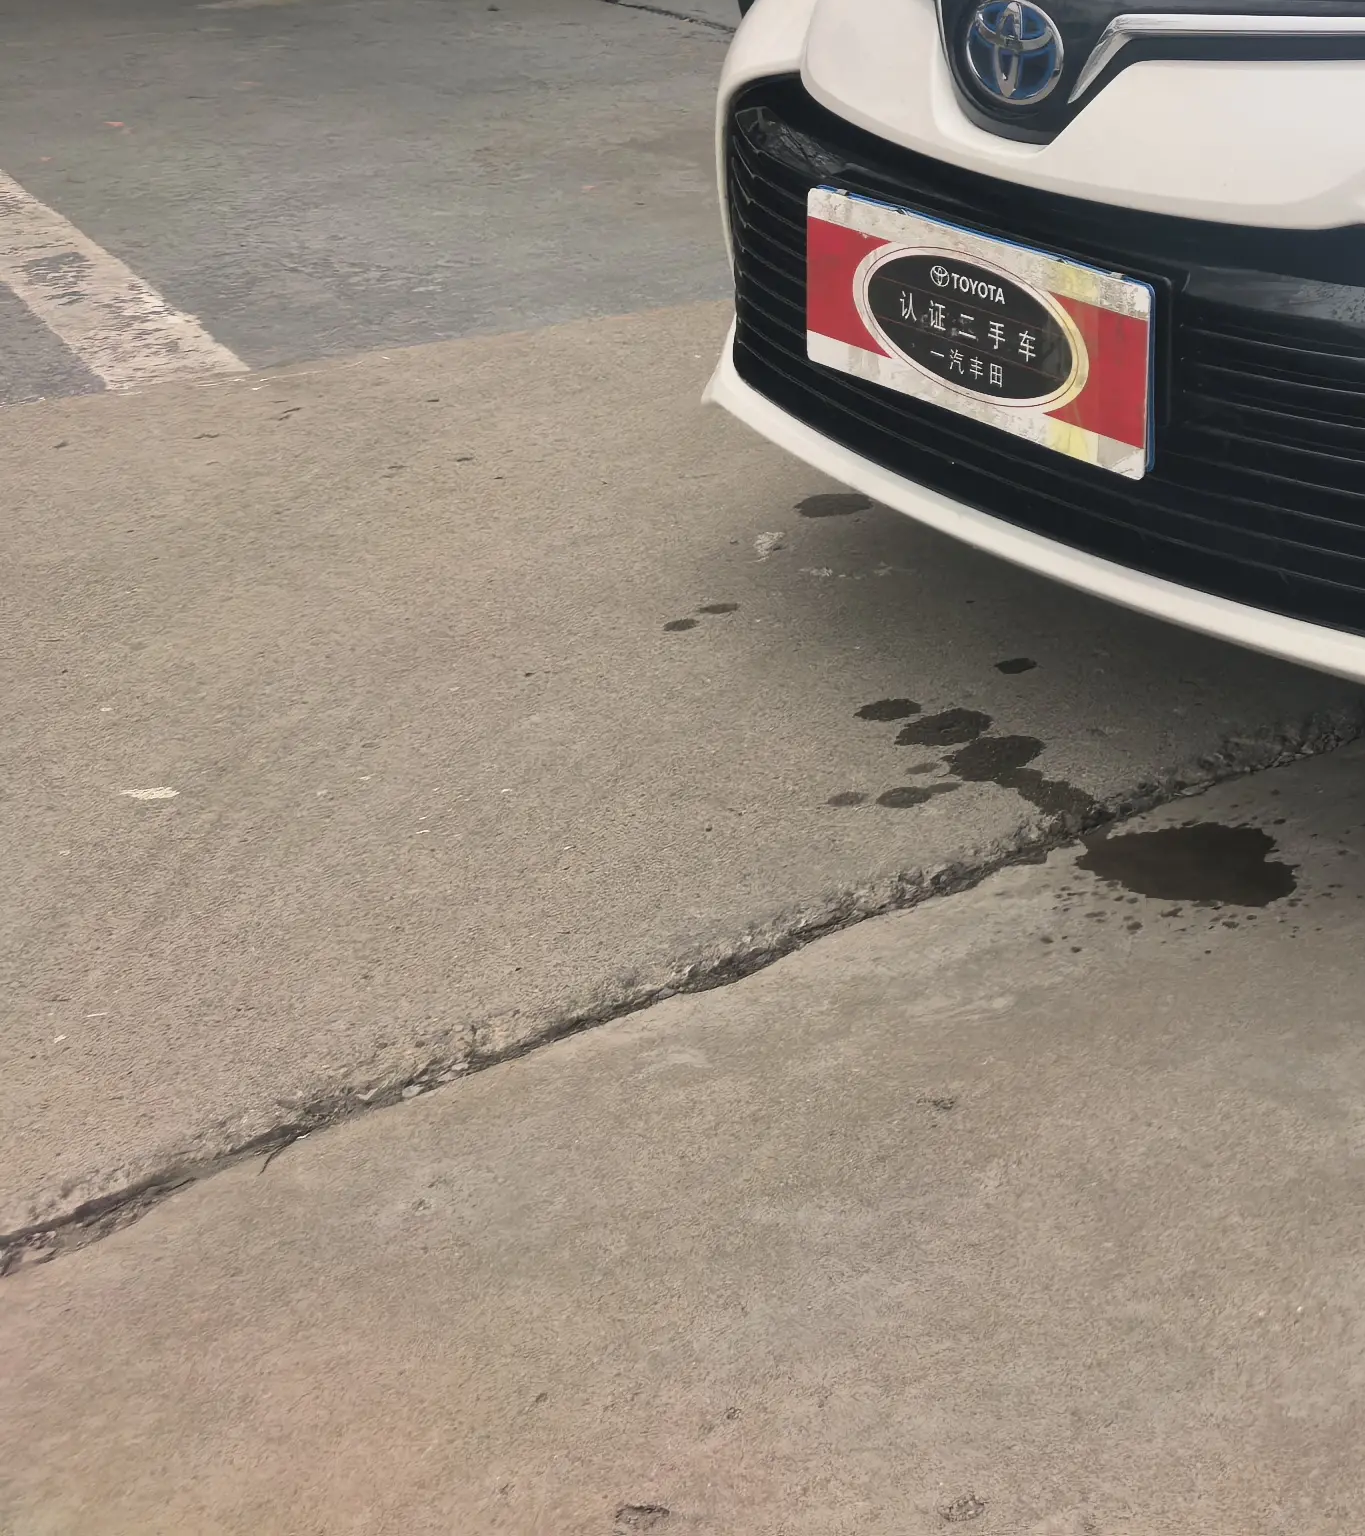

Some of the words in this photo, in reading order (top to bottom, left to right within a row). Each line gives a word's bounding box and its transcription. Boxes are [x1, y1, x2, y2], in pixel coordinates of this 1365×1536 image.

[951, 272, 1006, 305] TOYOTA
[899, 290, 1037, 362] 认证二手车
[930, 349, 1003, 388] 一汽丰田
